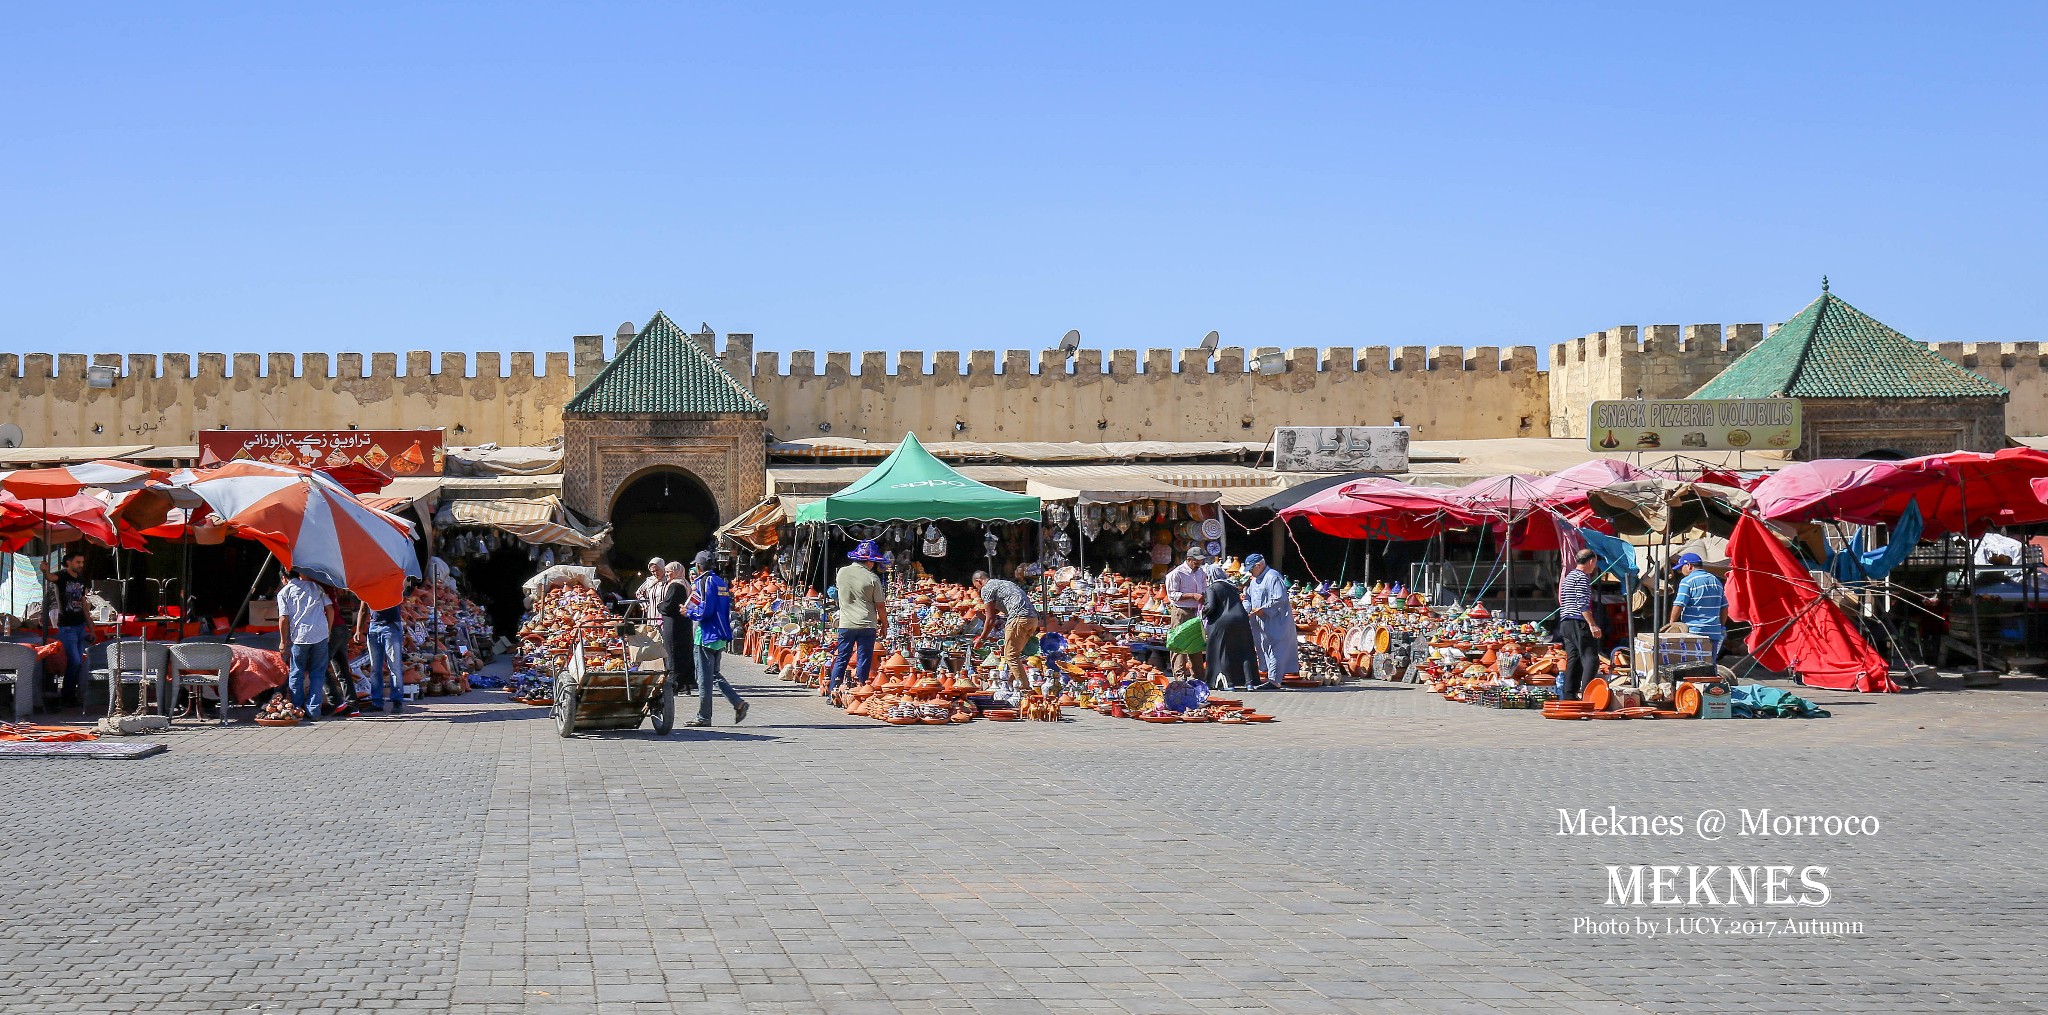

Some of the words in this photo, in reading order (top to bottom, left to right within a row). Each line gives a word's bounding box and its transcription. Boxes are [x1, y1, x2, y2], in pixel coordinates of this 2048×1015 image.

[1597, 404, 1646, 429] SNACK
[1650, 403, 1715, 428] PIZZERIA
[1719, 402, 1794, 427] VOLUBILIS
[243, 432, 284, 450] الوزاني
[285, 433, 327, 449] زكية
